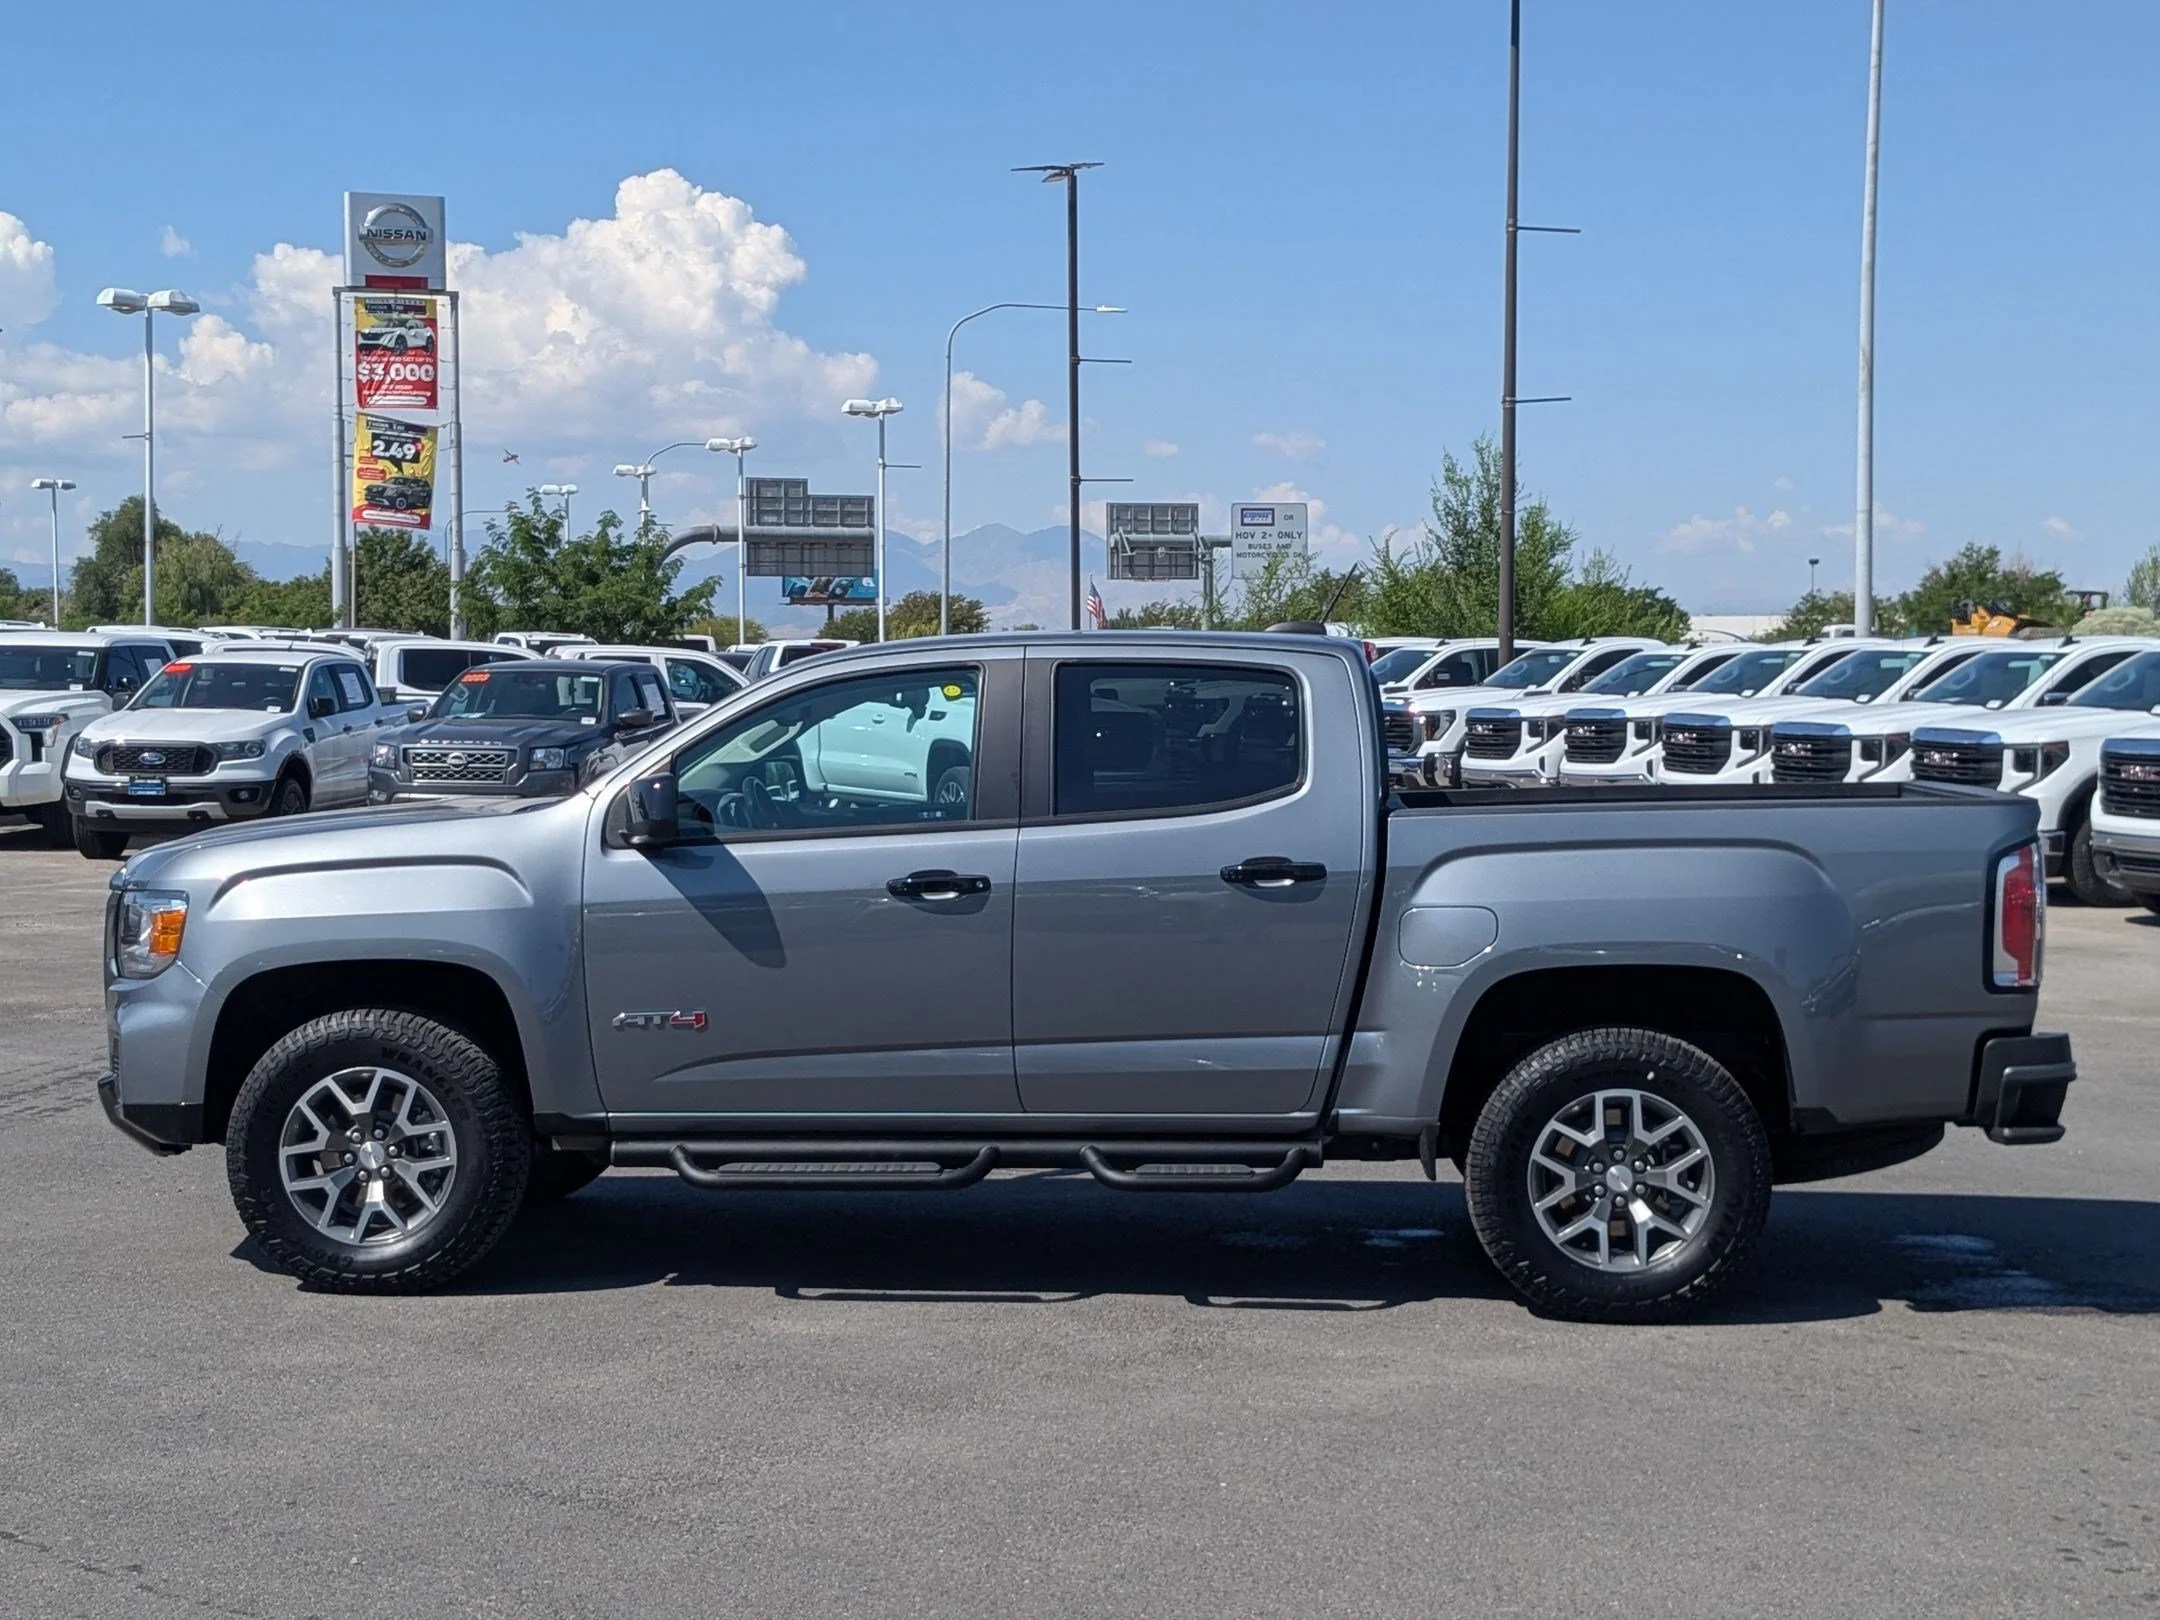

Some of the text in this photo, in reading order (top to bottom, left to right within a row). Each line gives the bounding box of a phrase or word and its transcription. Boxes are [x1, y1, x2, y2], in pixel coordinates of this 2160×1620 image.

[367, 228, 427, 241] NISSAN
[358, 361, 435, 385] $3,000
[1235, 531, 1256, 540] HOV
[1277, 531, 1303, 540] ONLY
[612, 1010, 705, 1028] AT4
